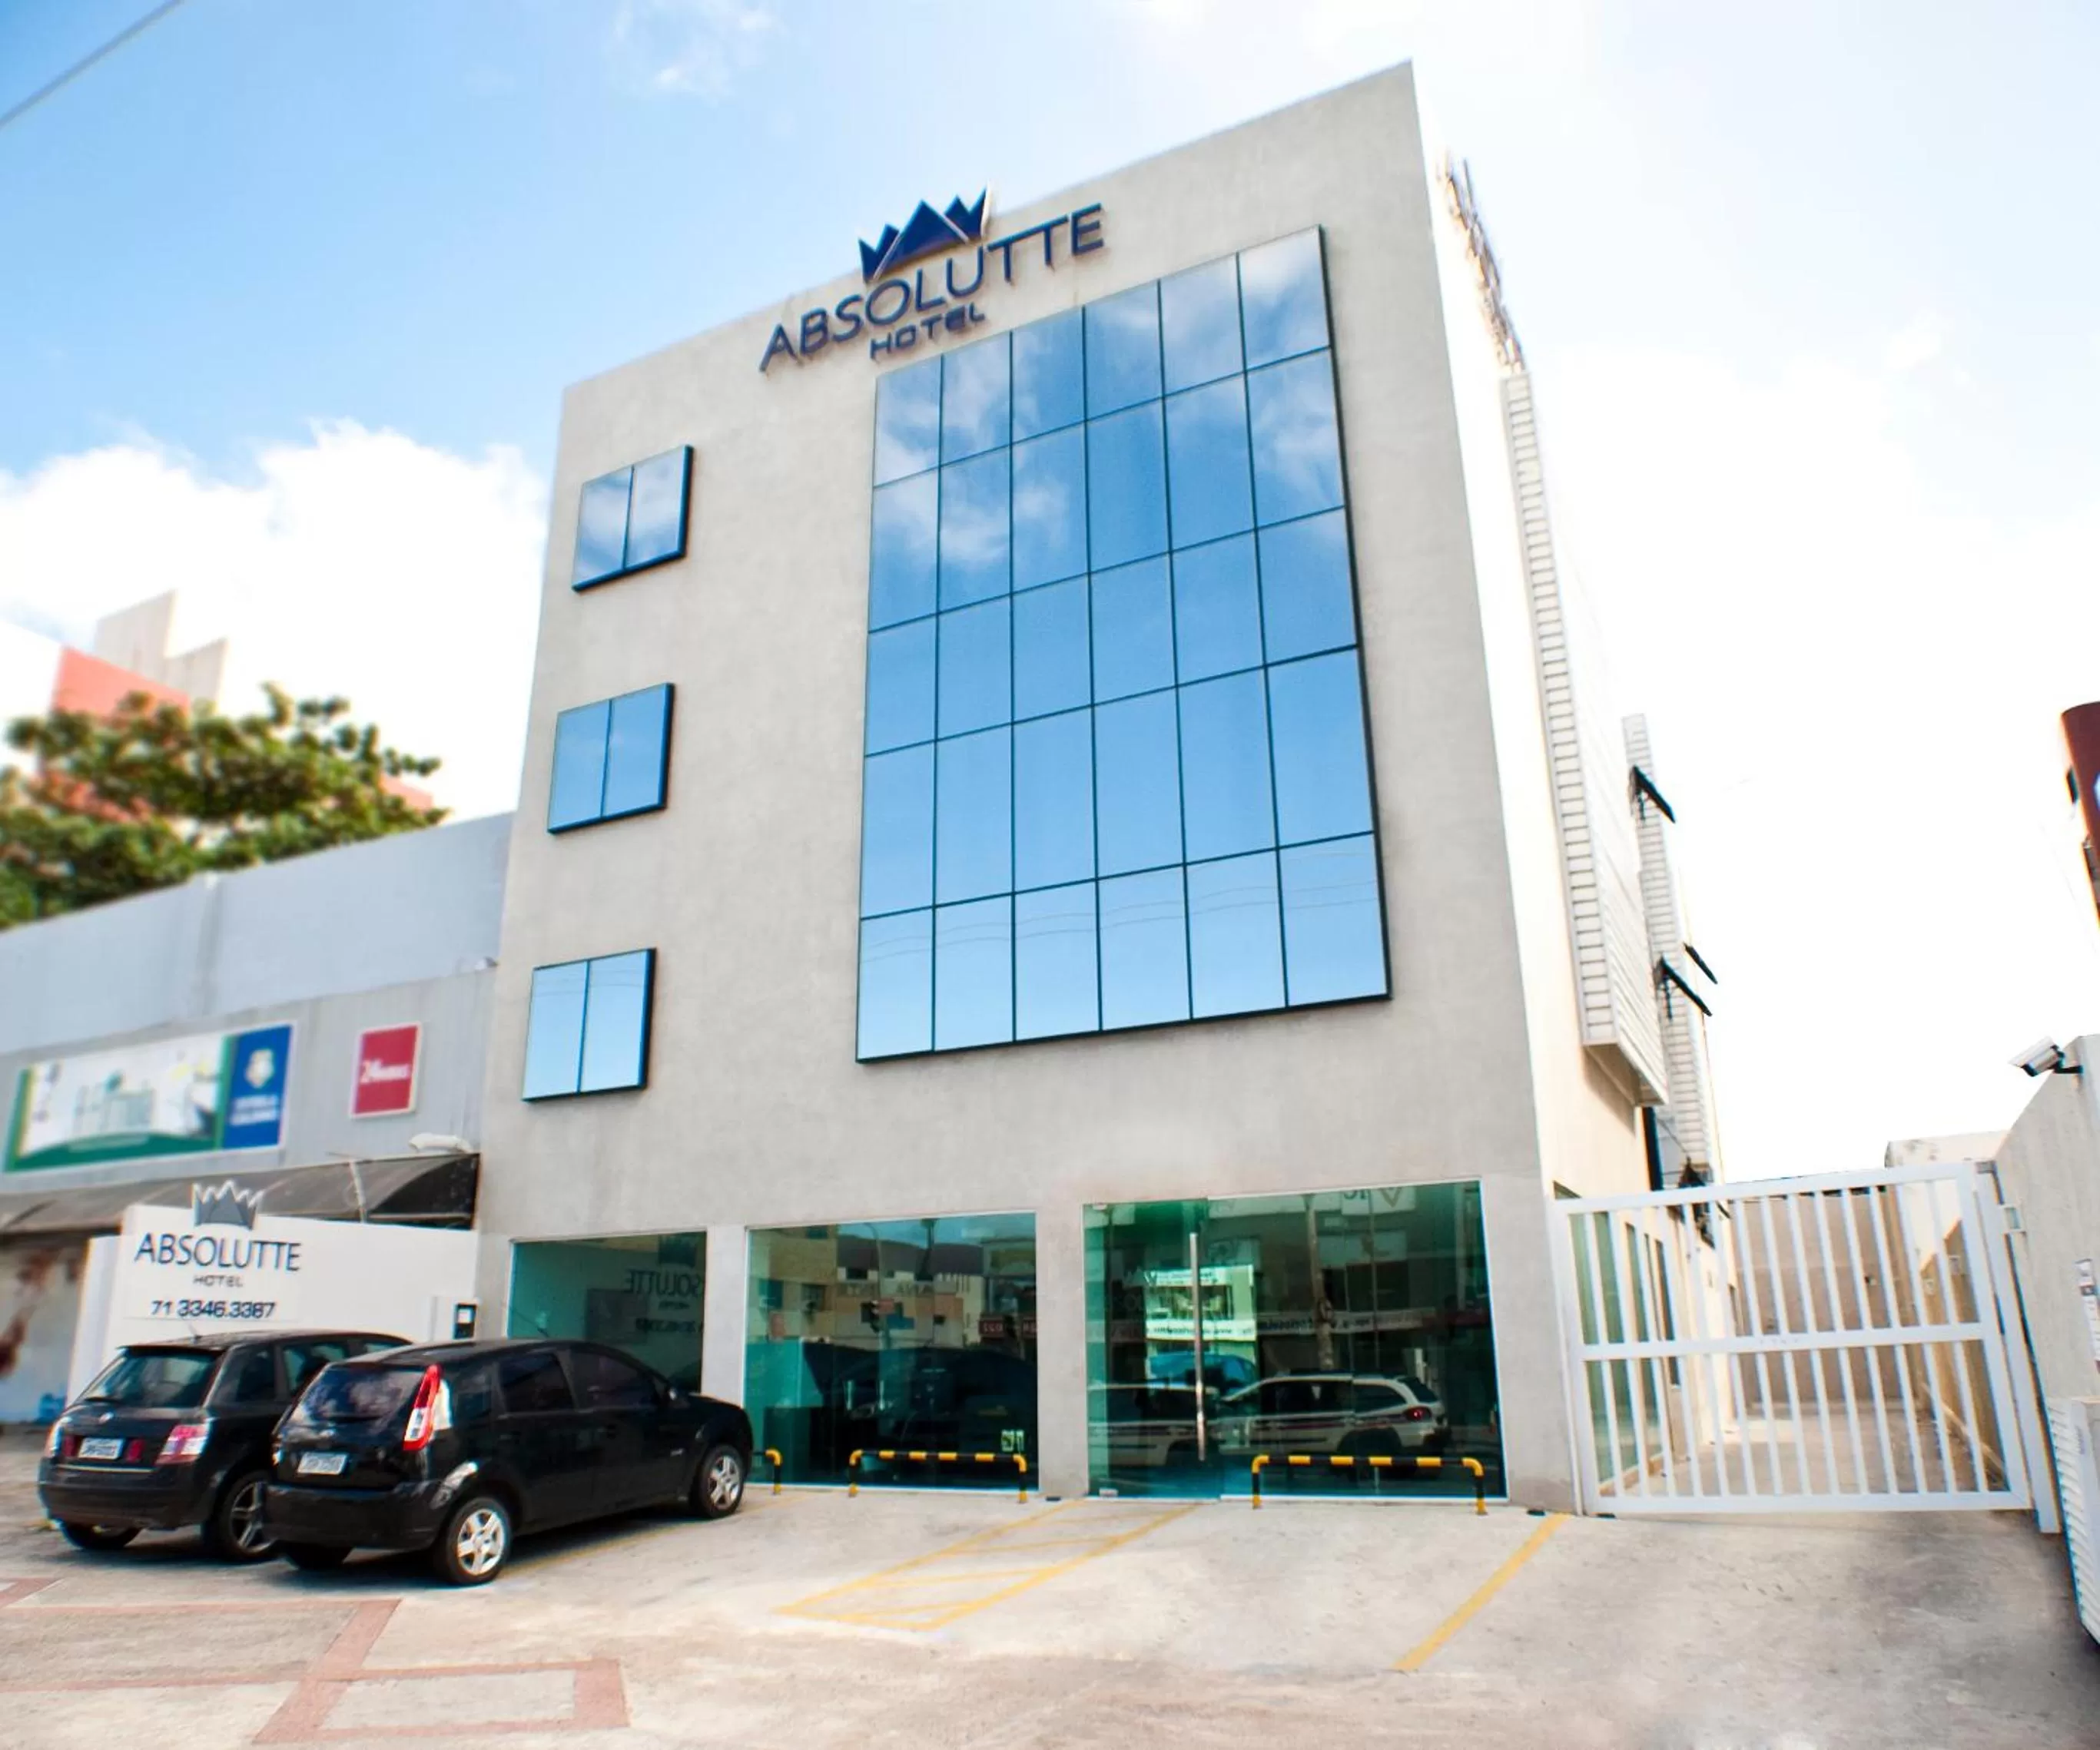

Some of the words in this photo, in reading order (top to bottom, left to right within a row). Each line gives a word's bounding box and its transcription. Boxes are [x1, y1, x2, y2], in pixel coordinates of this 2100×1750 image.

[758, 202, 1105, 372] ABSOLUTTE
[869, 302, 986, 360] HOTEL
[134, 1232, 302, 1271] ABSOLUTTE
[193, 1274, 244, 1288] HOTEL
[151, 1300, 173, 1315] 71
